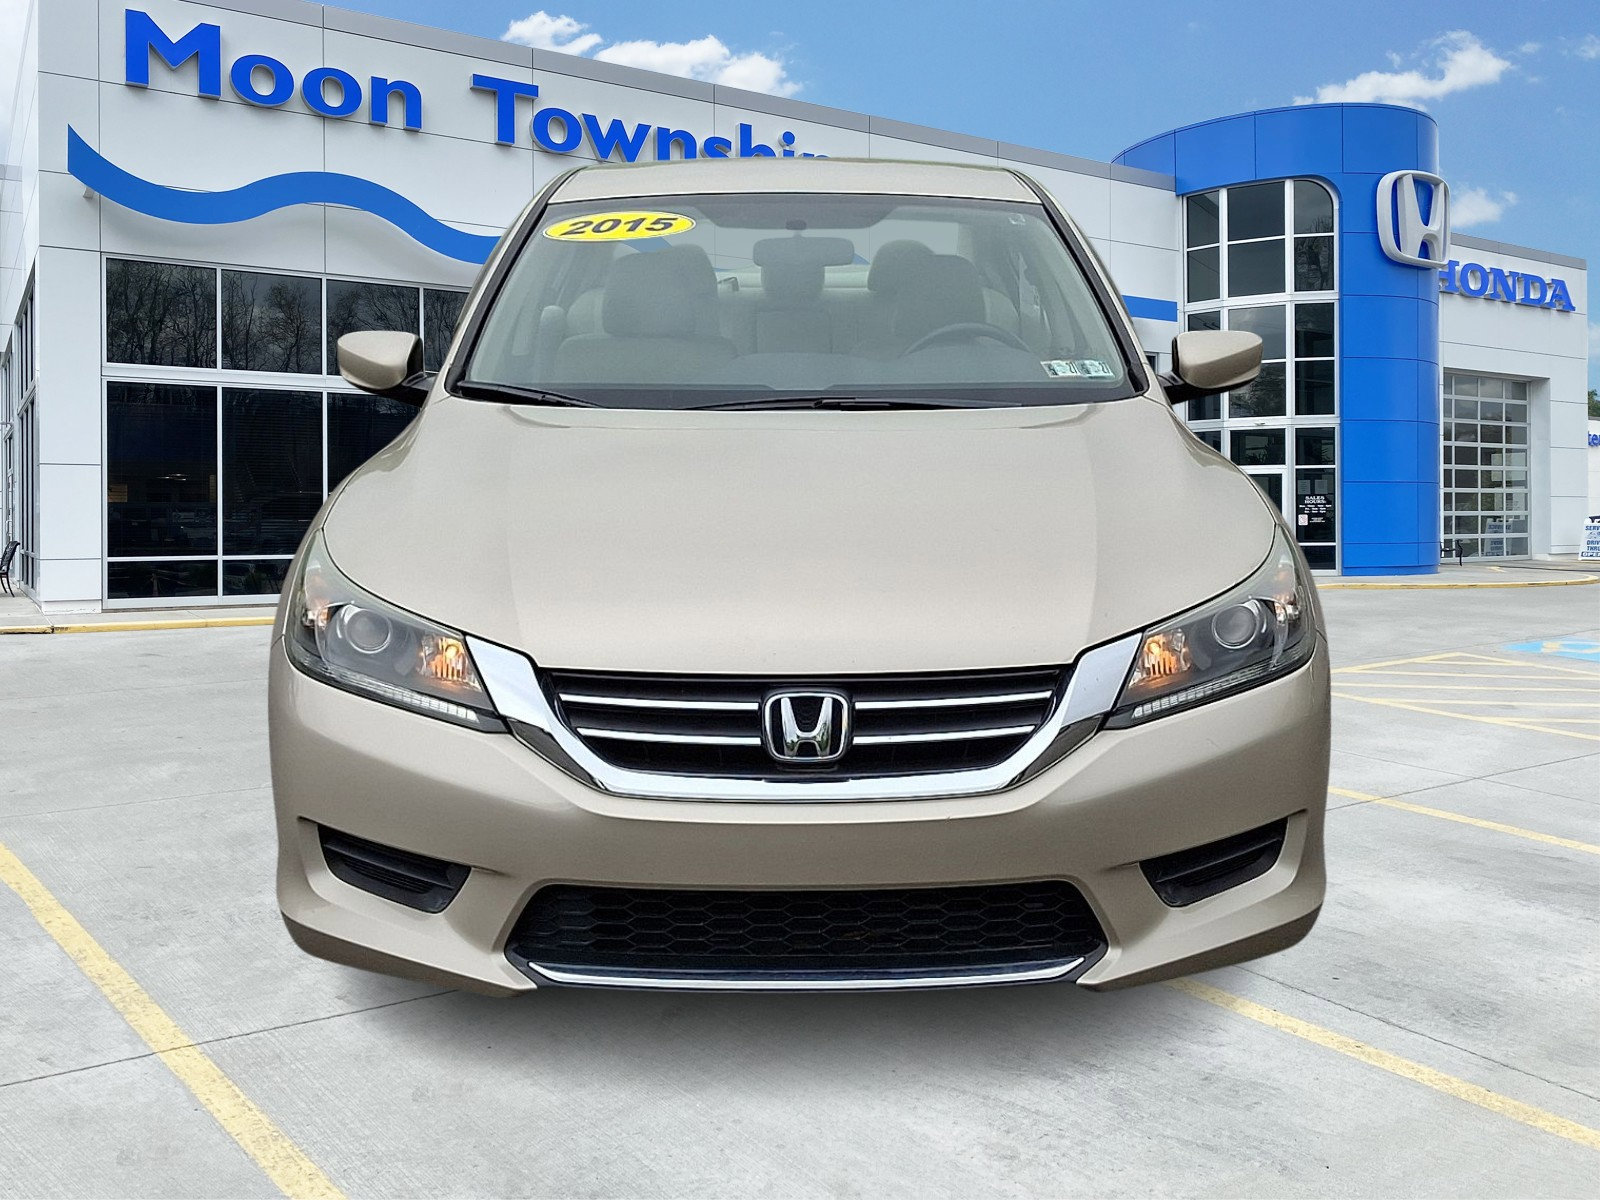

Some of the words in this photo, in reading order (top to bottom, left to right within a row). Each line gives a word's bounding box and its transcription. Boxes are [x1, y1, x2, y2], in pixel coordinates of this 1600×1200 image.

[125, 8, 423, 132] Moon
[560, 217, 679, 236] 2015
[1438, 259, 1576, 312] HONDA
